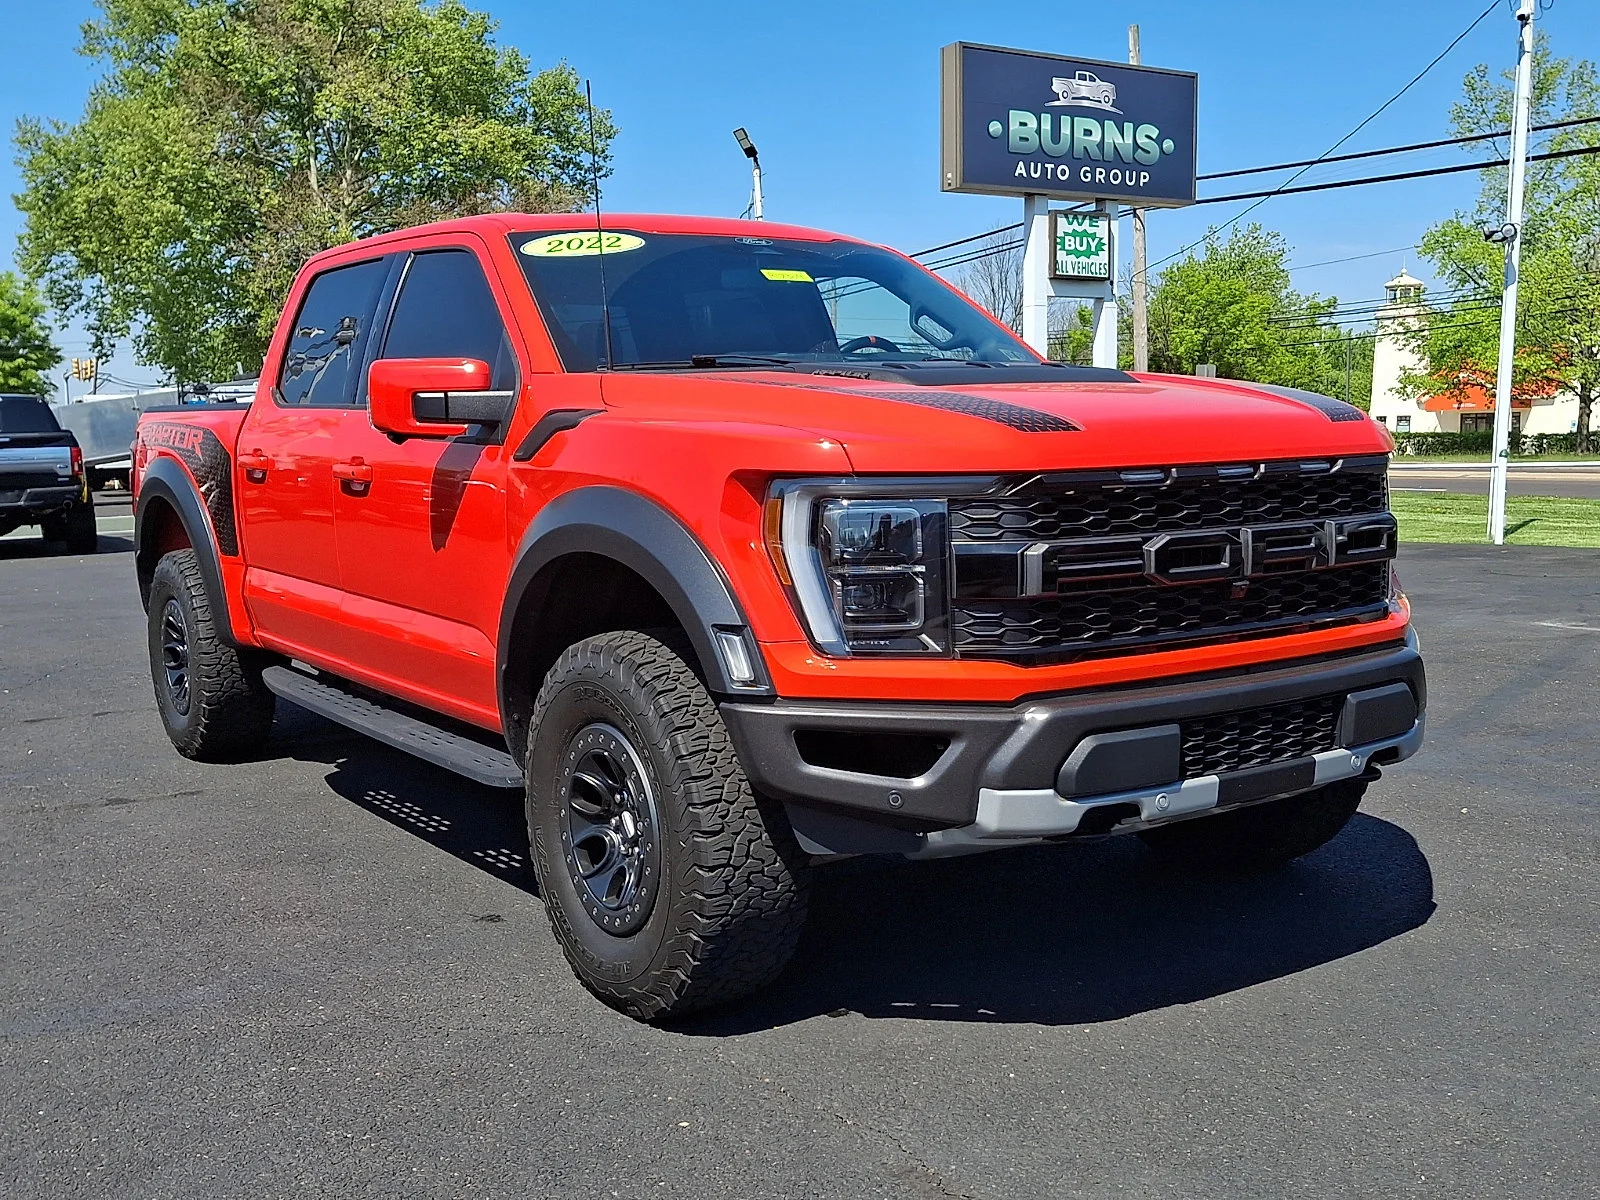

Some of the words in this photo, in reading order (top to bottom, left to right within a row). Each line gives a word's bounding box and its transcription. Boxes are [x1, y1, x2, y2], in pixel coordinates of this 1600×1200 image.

[1007, 109, 1161, 166] BURNS
[1014, 160, 1070, 181] AUTO
[1079, 166, 1150, 187] GROUP
[1063, 213, 1100, 228] WE
[546, 235, 622, 253] 2022
[1064, 235, 1100, 252] BUY
[1071, 260, 1108, 276] VEHICLES
[1023, 510, 1398, 598] FORD
